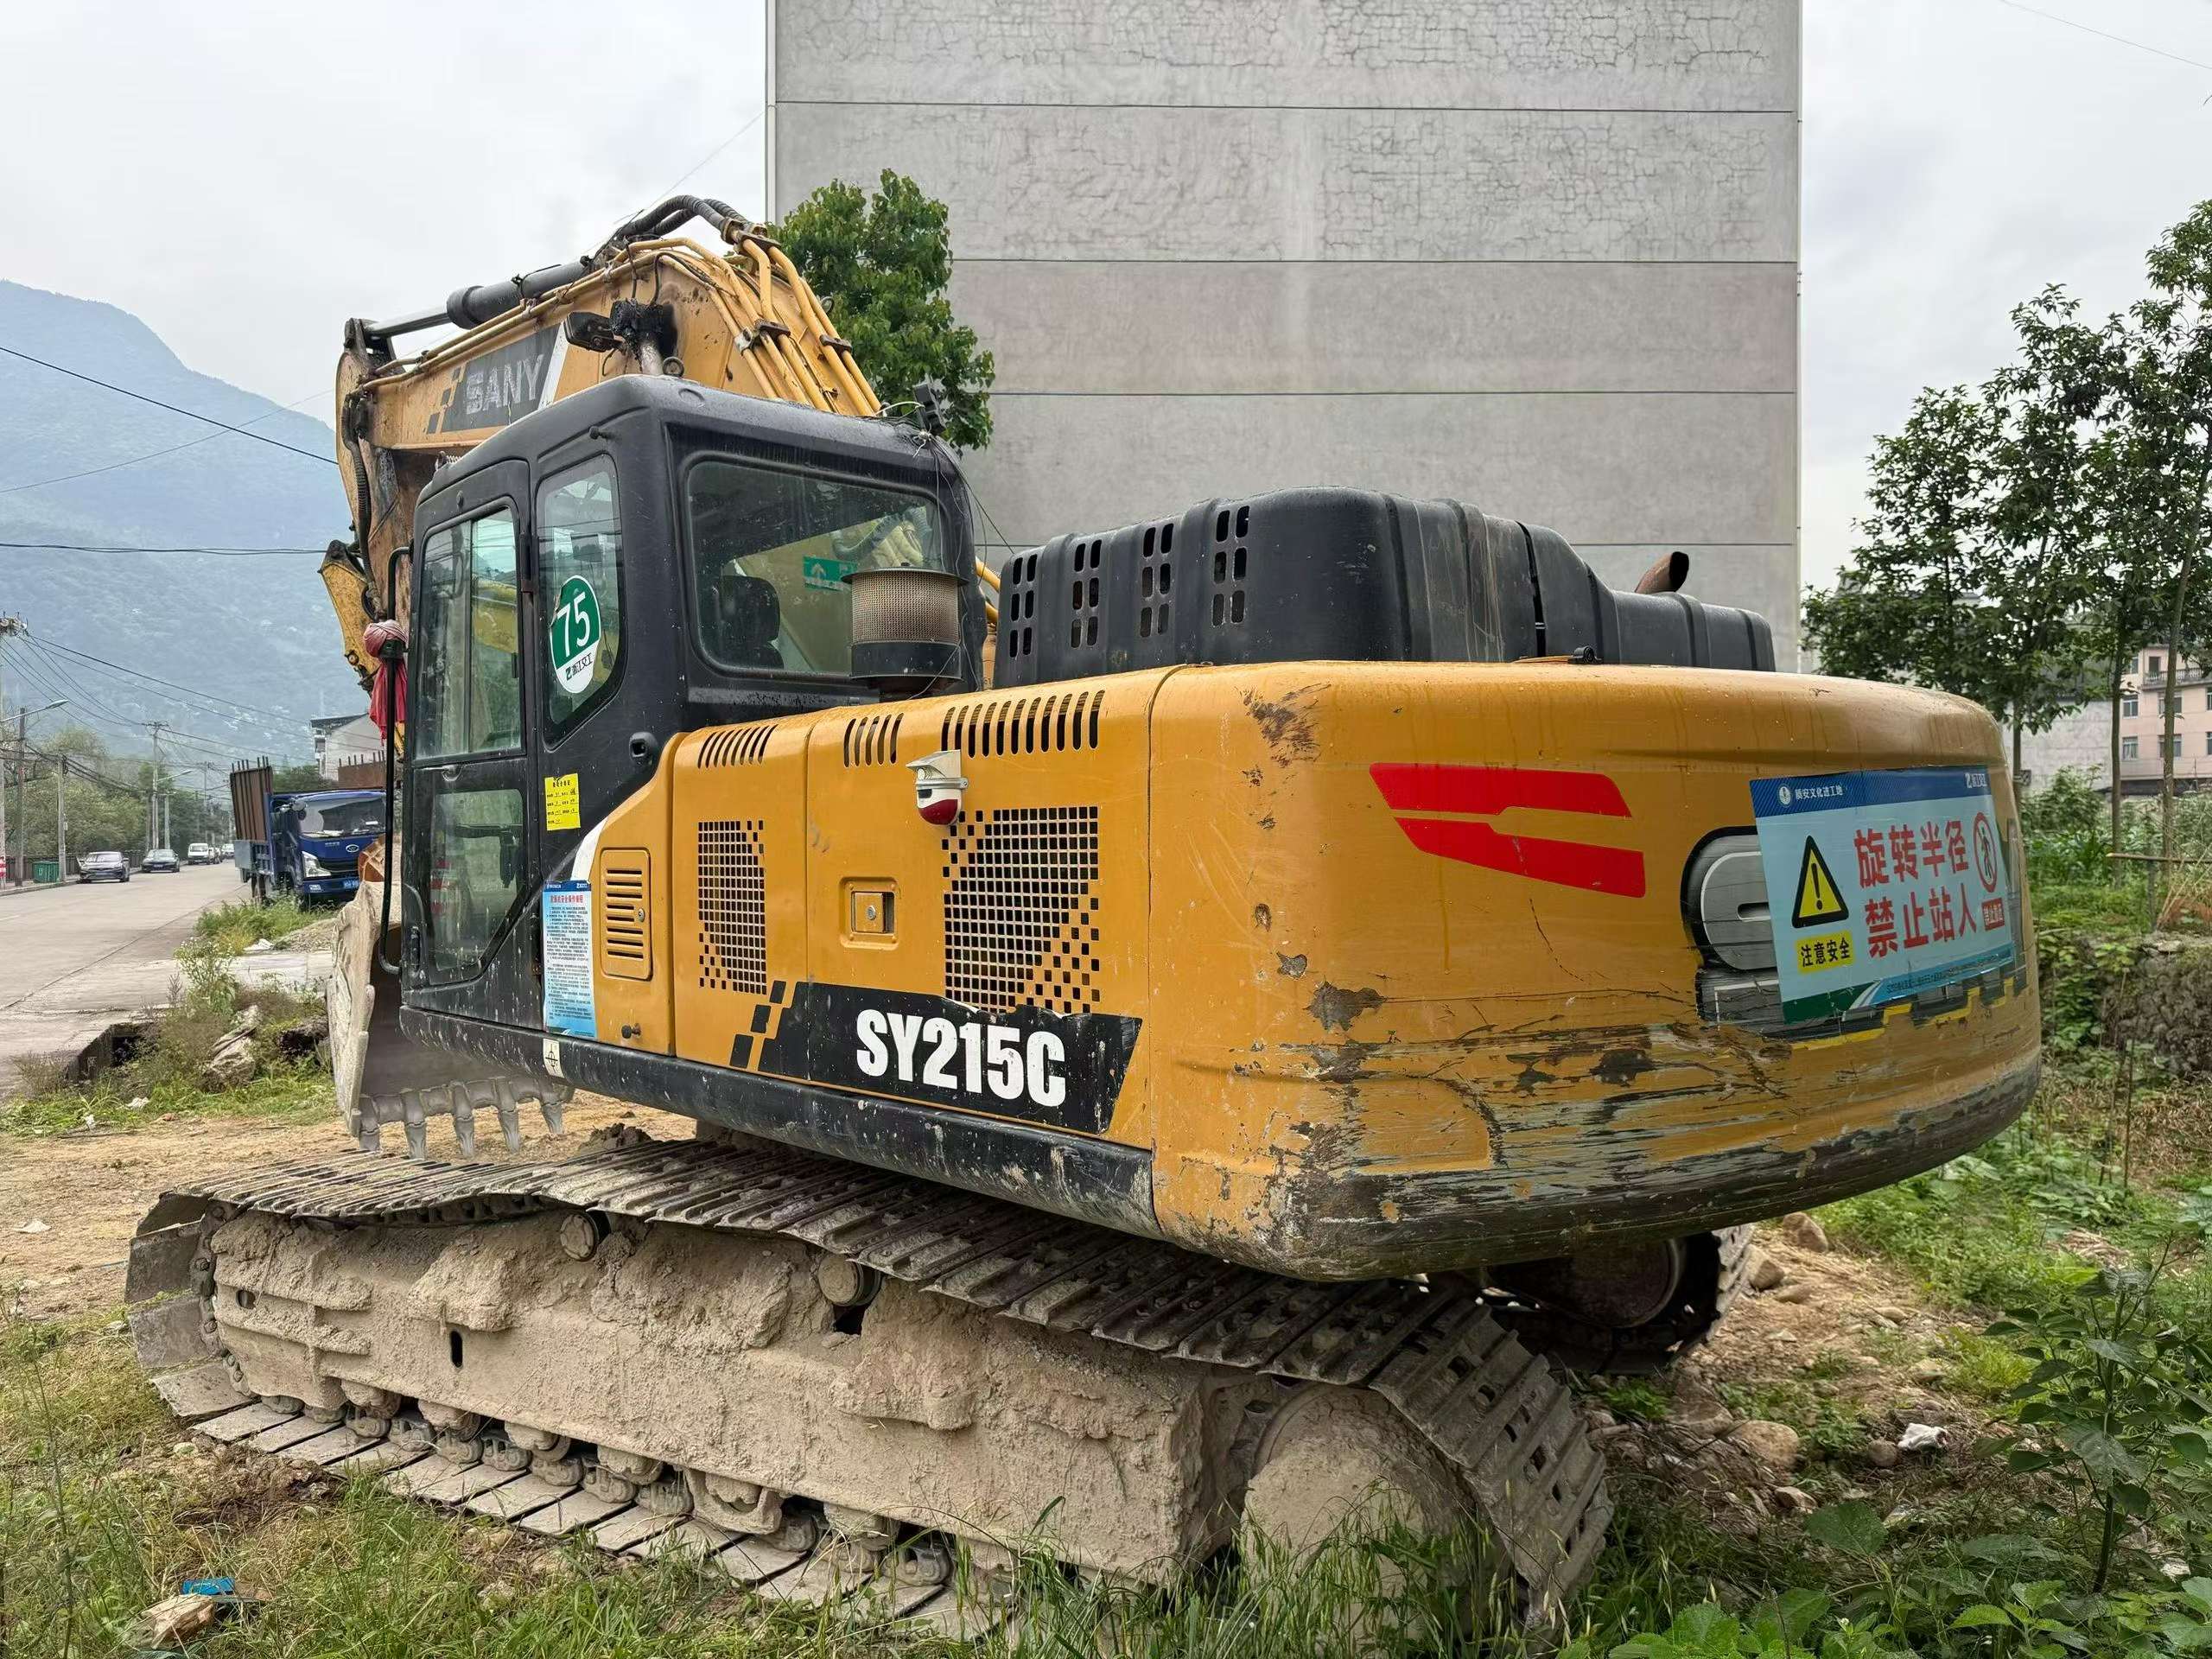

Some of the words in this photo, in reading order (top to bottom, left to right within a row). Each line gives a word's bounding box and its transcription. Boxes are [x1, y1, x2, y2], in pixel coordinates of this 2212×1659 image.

[466, 353, 545, 416] SANY
[556, 591, 591, 658] 75
[1854, 820, 1969, 888] 旋转半径
[1801, 937, 1851, 968] 注意安全
[1865, 882, 1977, 958] 禁止站人
[856, 1009, 1066, 1107] SY215C
